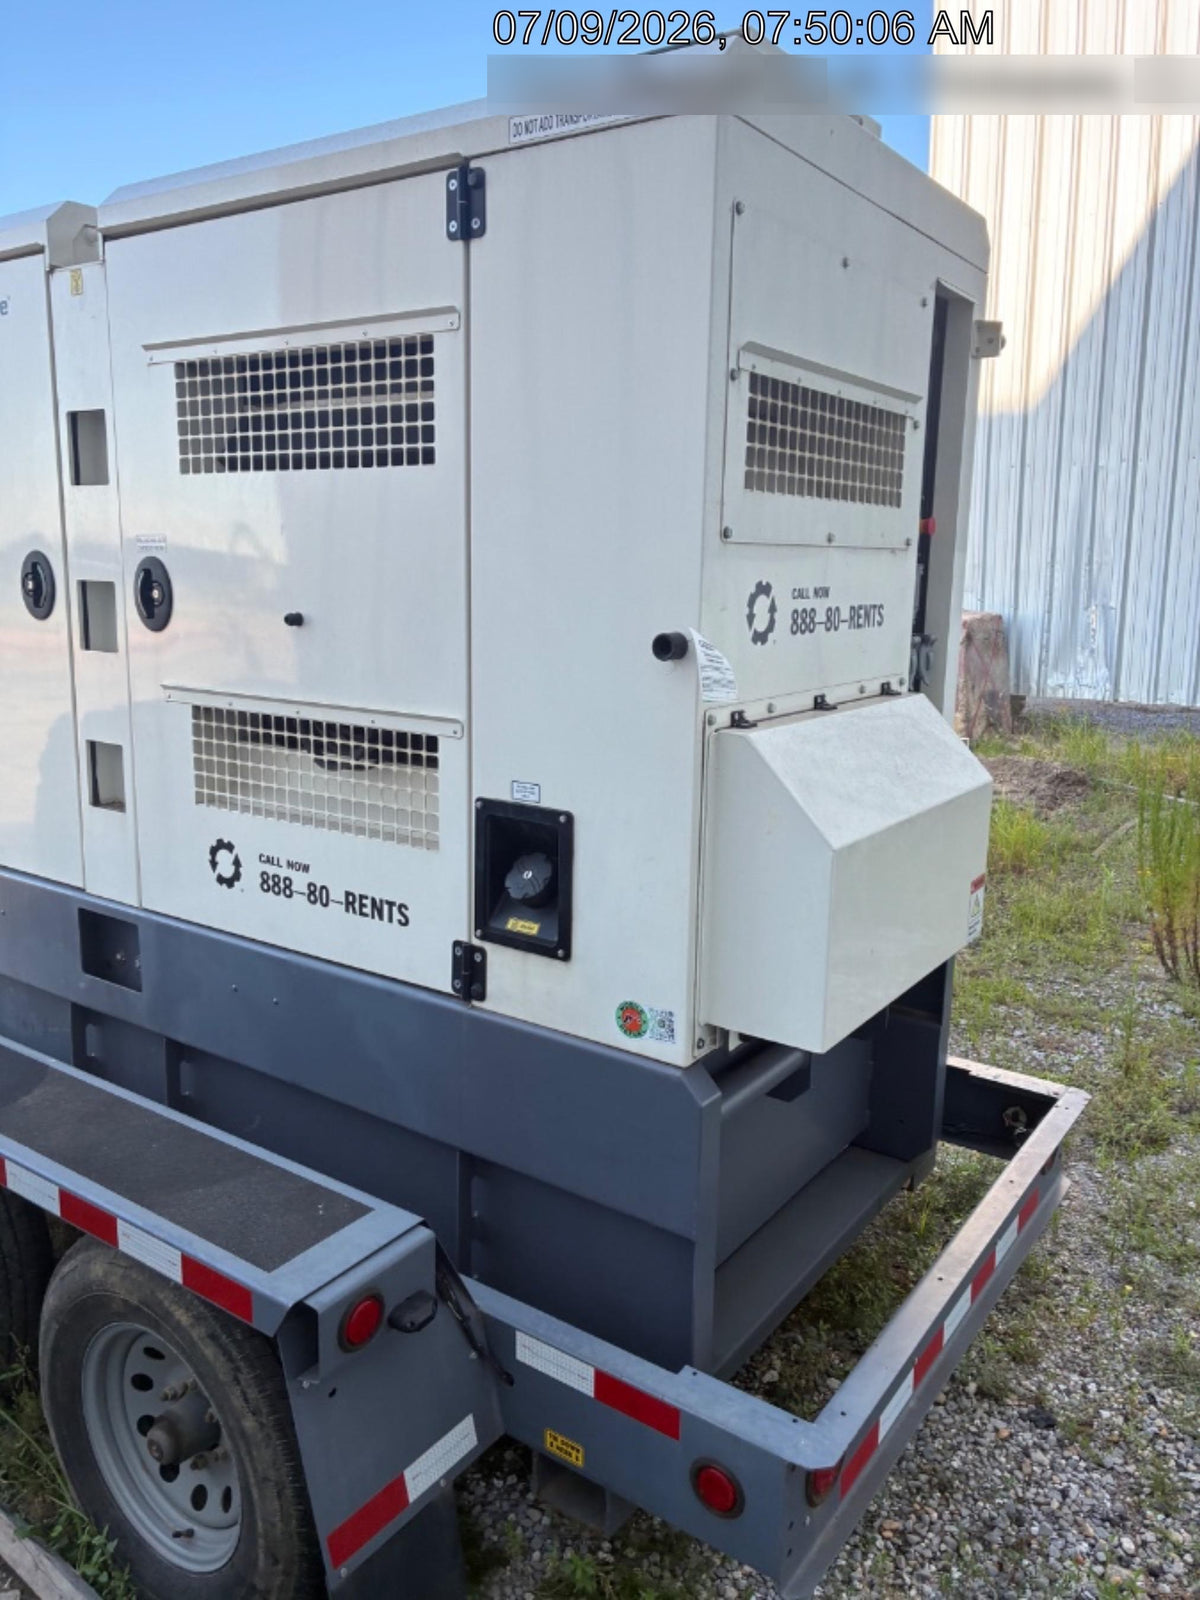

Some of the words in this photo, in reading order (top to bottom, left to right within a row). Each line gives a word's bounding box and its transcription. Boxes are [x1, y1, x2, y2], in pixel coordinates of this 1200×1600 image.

[524, 118, 538, 135] NOT
[792, 588, 810, 600] CALL
[813, 586, 831, 599] NOW
[790, 604, 885, 635] 888-80-RENTS
[258, 853, 283, 868] CALL
[286, 860, 310, 873] NOW
[259, 871, 410, 927] 888-80-RENTS
